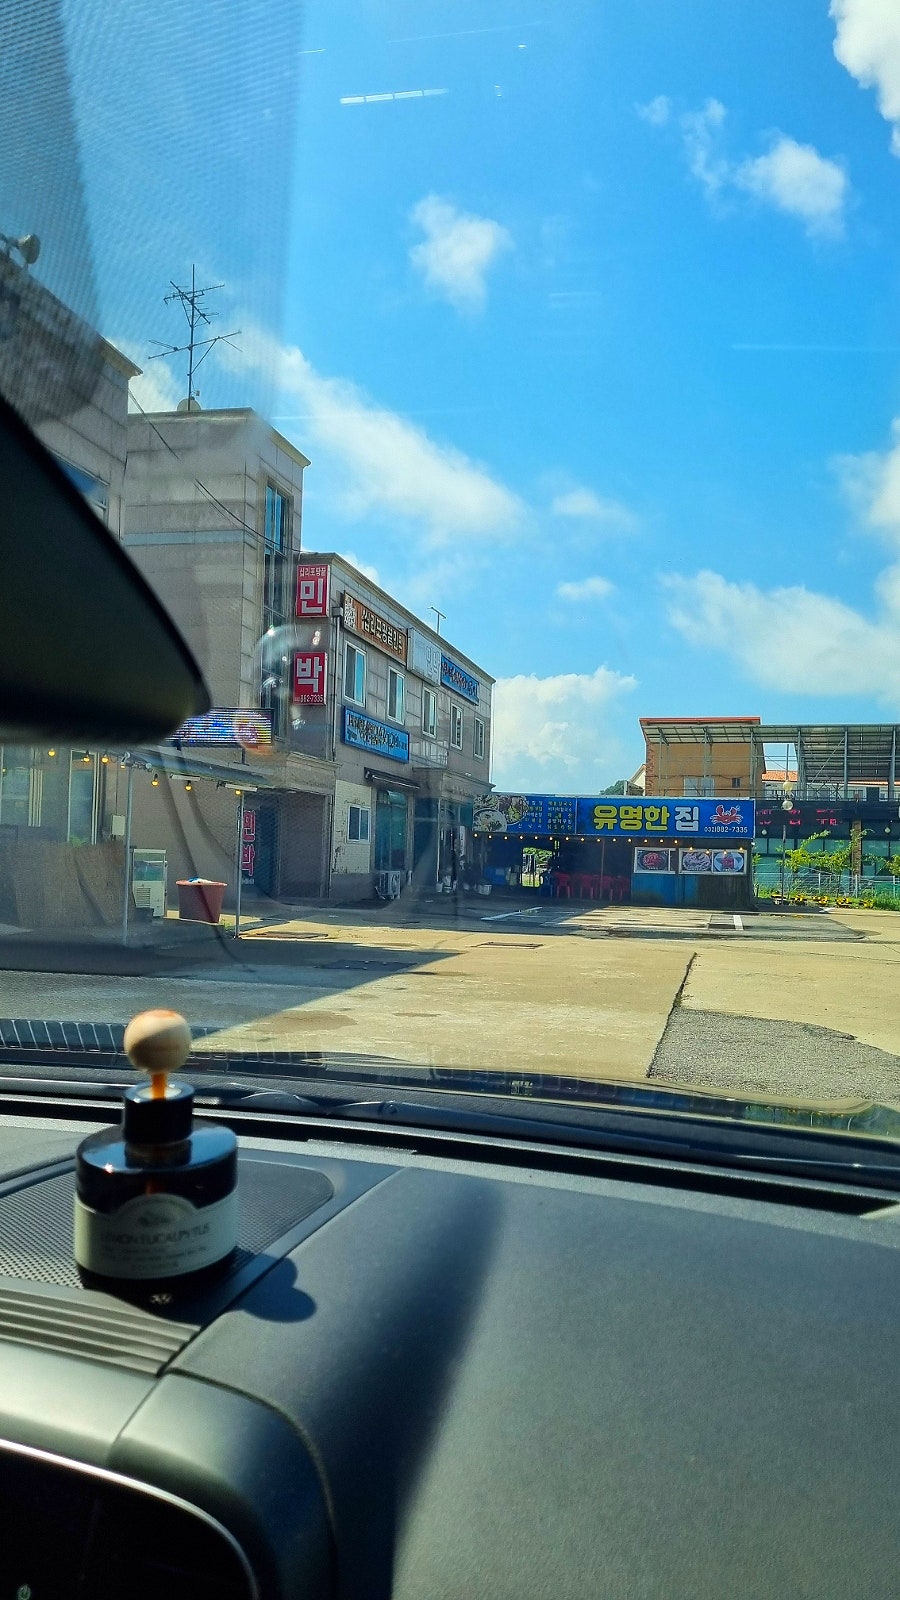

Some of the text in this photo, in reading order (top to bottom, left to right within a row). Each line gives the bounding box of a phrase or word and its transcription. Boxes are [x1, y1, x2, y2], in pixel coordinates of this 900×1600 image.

[300, 578, 323, 614] 민
[296, 656, 322, 693] 박
[593, 805, 699, 832] 유명한 집
